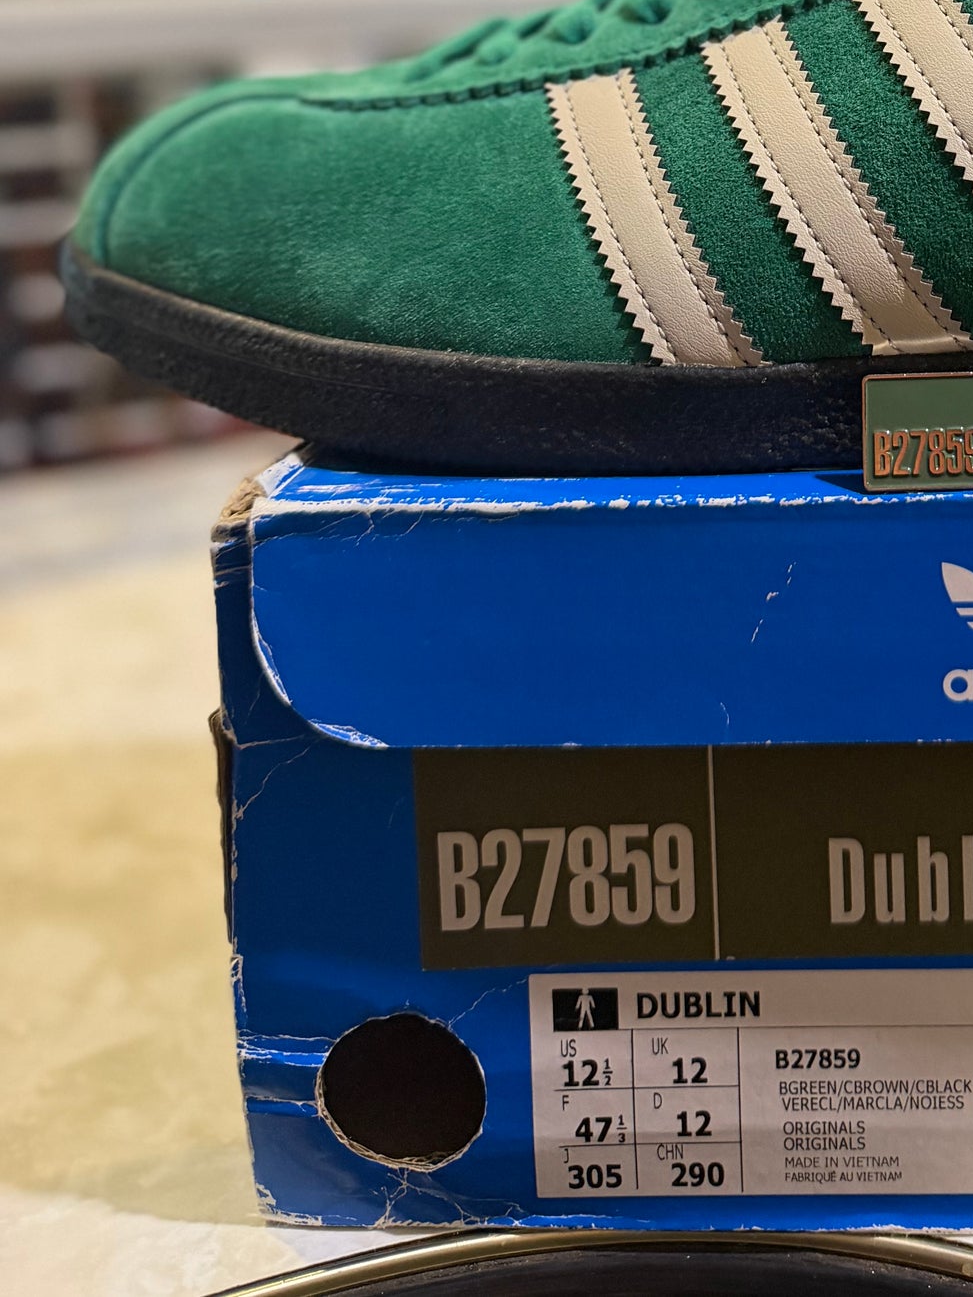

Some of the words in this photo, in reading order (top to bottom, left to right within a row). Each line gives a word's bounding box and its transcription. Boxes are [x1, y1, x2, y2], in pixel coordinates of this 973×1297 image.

[437, 822, 696, 931] B27859
[637, 991, 760, 1019] DUBLIN
[560, 1039, 577, 1057] US
[652, 1037, 669, 1055] UK
[775, 1048, 861, 1070] B27859
[672, 1057, 708, 1084] 12
[779, 1079, 972, 1096] BGREEN/CBROWN/CBLACK
[562, 1095, 570, 1111] F
[653, 1092, 663, 1109] D
[781, 1095, 965, 1113] VERECL/MARCLA/NOIESS
[677, 1110, 712, 1137] 12
[783, 1120, 866, 1135] ORIGINALS
[656, 1144, 684, 1160] CHN
[783, 1137, 866, 1151] ORIGINALS
[563, 1148, 569, 1163] J
[785, 1157, 820, 1168] MADE
[825, 1156, 839, 1168] IN
[843, 1156, 900, 1168] VIETNAM
[568, 1164, 622, 1189] 305
[671, 1162, 725, 1187] 290
[839, 1172, 853, 1182] AU
[856, 1171, 902, 1182] VIETNAM
